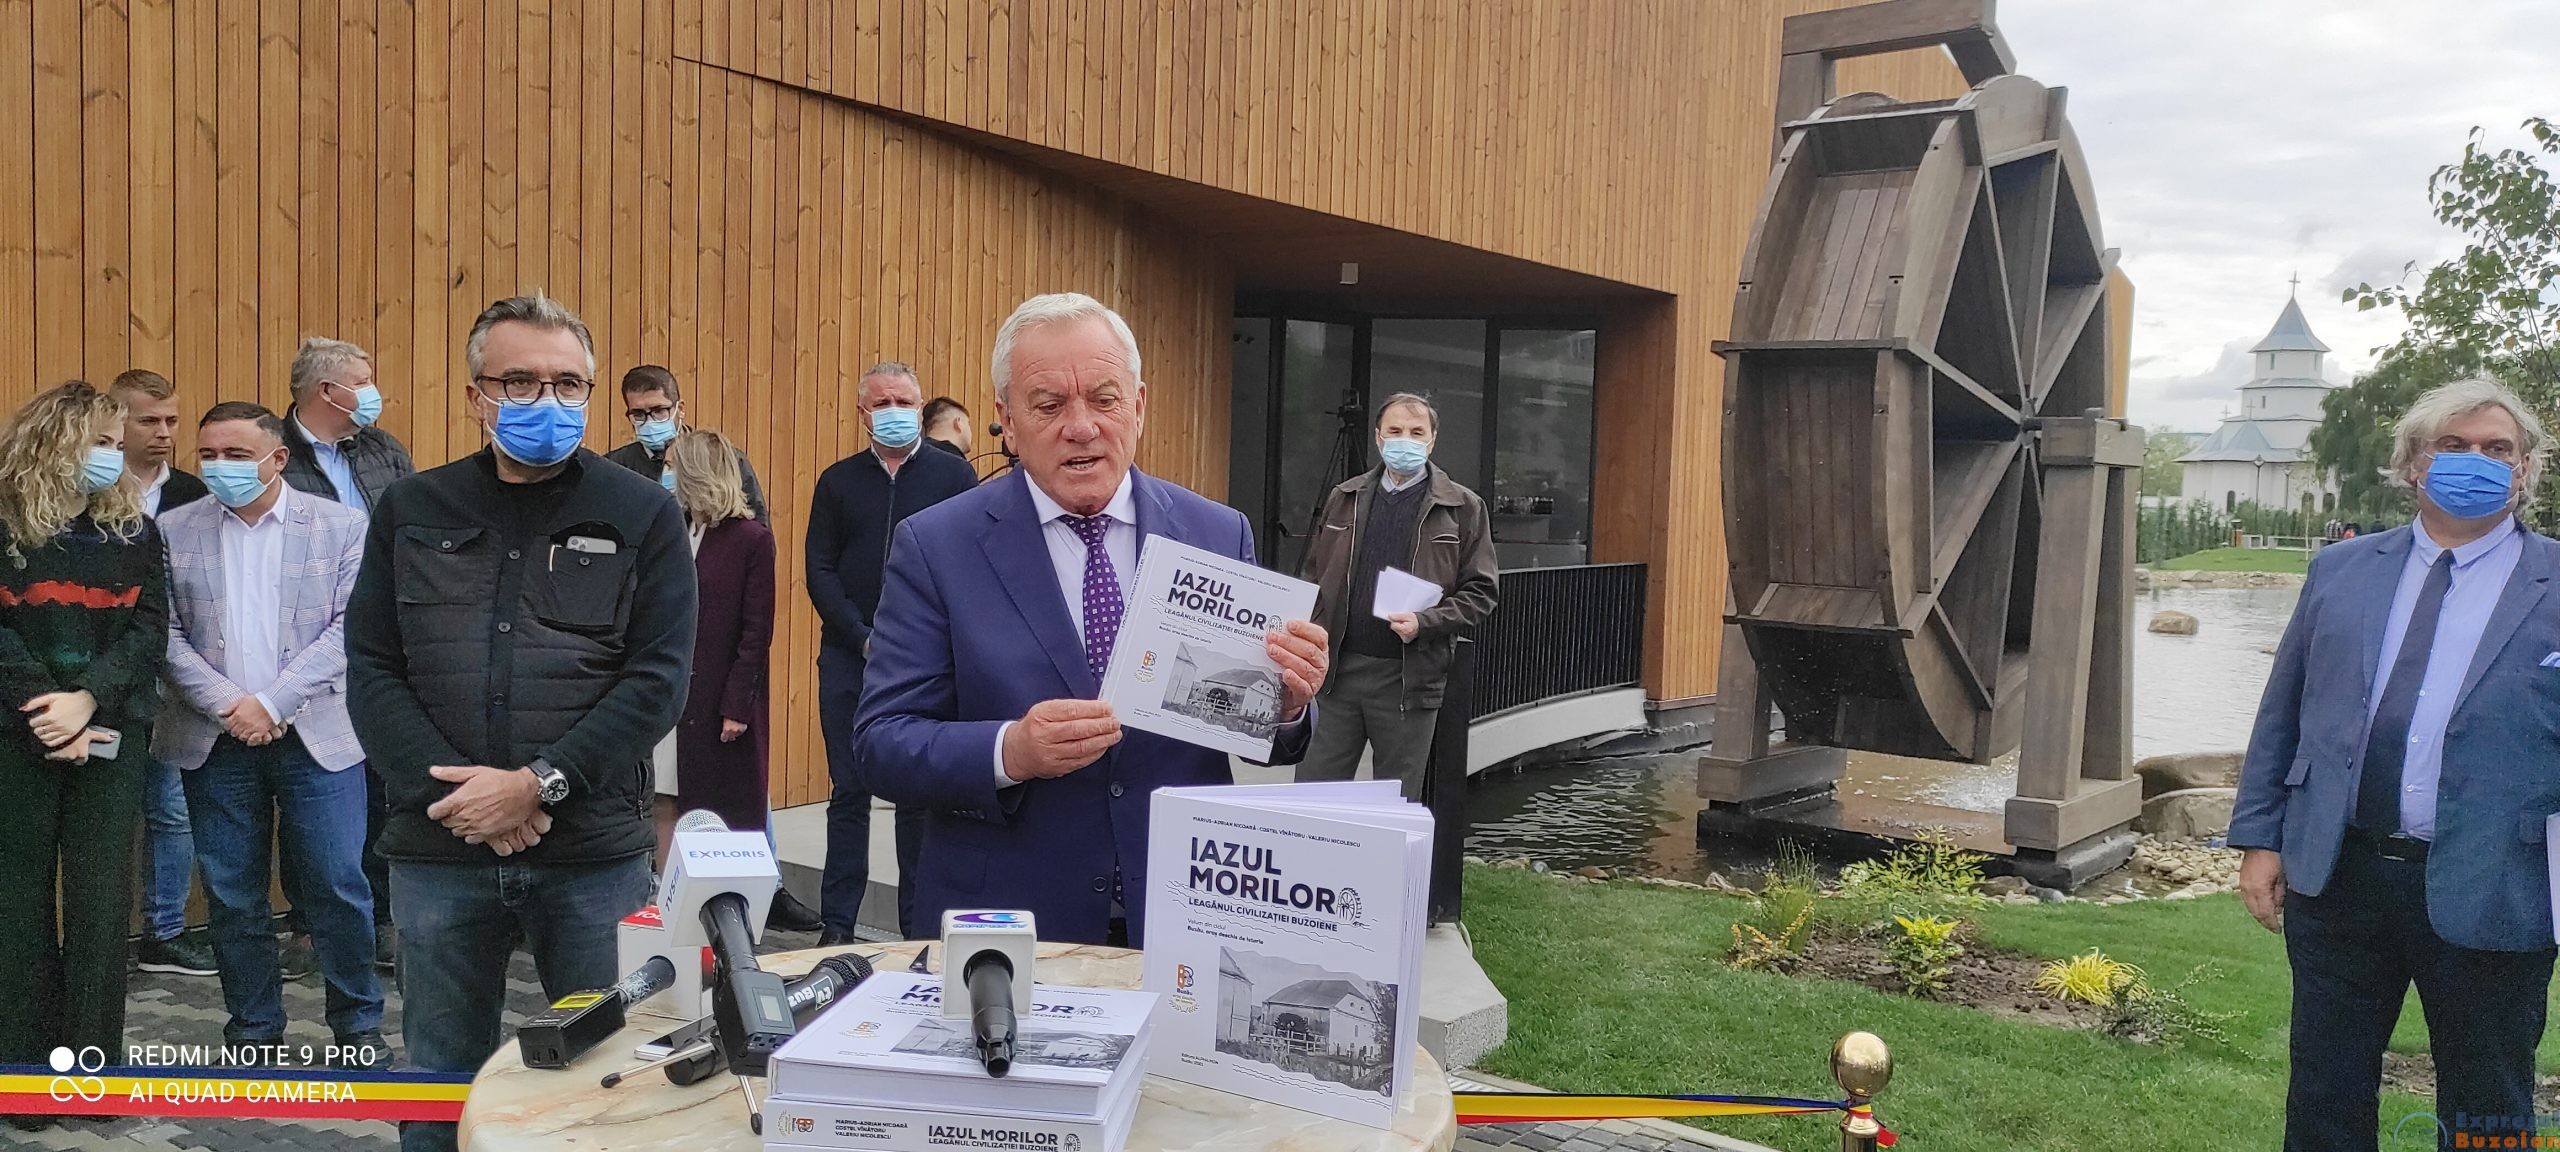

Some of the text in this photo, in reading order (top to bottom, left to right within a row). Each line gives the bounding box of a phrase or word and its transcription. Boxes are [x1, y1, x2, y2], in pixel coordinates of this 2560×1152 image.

[1173, 568, 1235, 602] IAZUL
[1168, 587, 1267, 630] MORILOR
[1234, 628, 1264, 642] BUZOIENE
[689, 850, 765, 859] EXPLORIS
[1191, 836, 1282, 875] IAZUL
[1189, 865, 1336, 915] MORILOR
[1291, 916, 1338, 932] BUZOIENE
[929, 1125, 1058, 1146] IAZUL MORILOR
[1019, 1144, 1058, 1152] BUZOIENE
